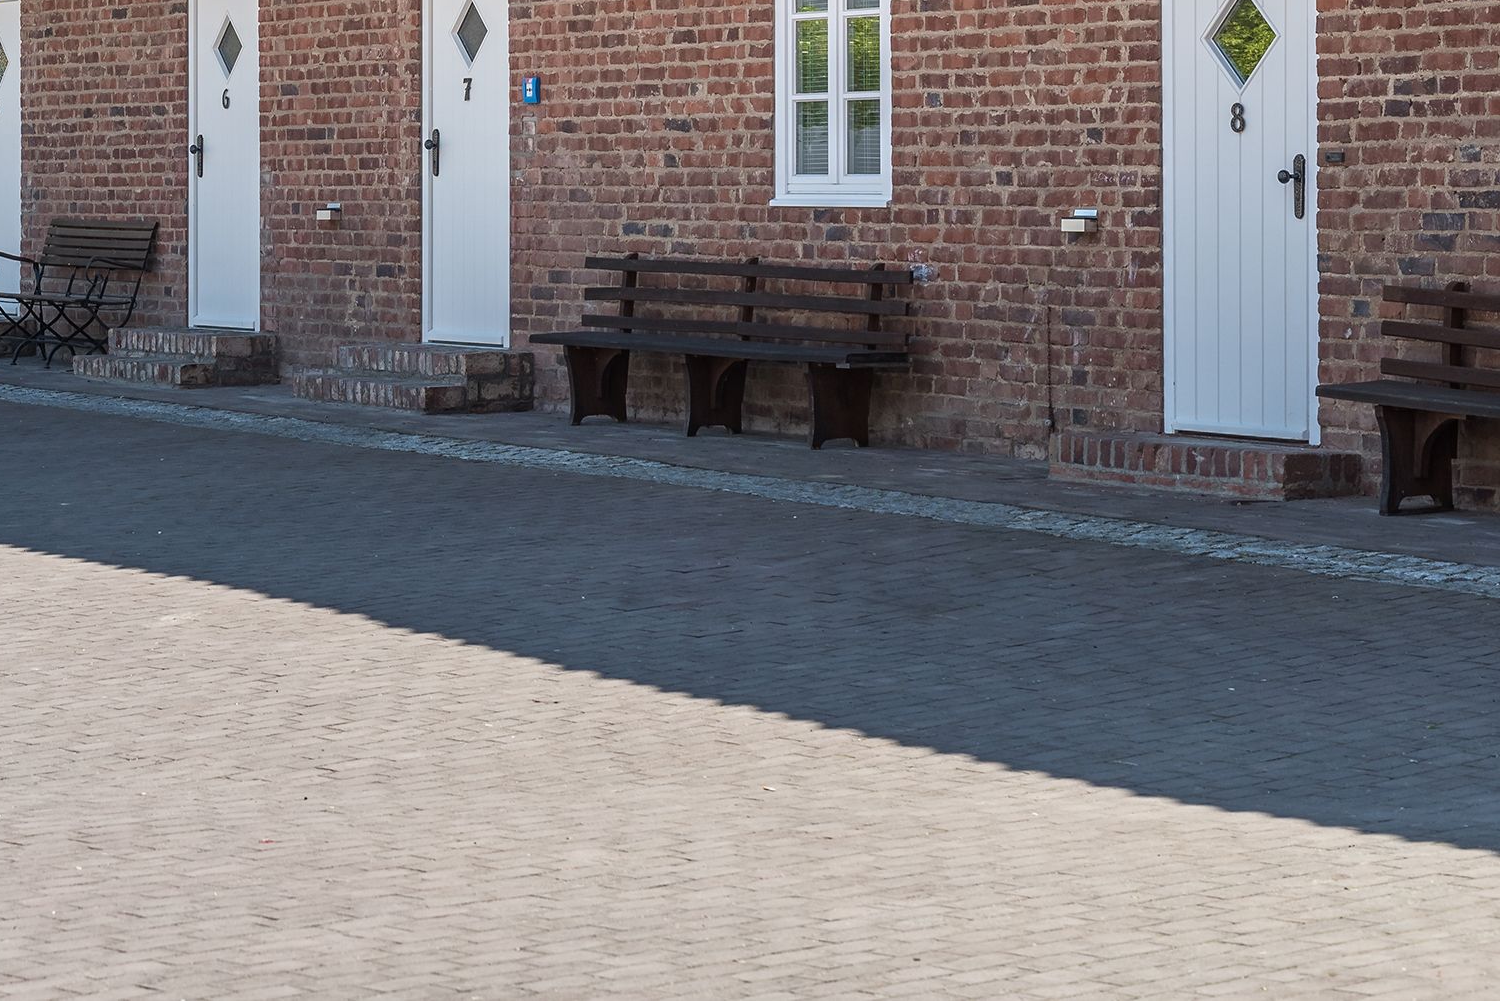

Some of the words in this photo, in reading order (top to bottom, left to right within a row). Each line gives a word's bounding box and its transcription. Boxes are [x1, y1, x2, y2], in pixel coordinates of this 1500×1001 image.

[222, 88, 230, 110] 6
[463, 78, 473, 101] 7
[1230, 102, 1246, 133] 8
